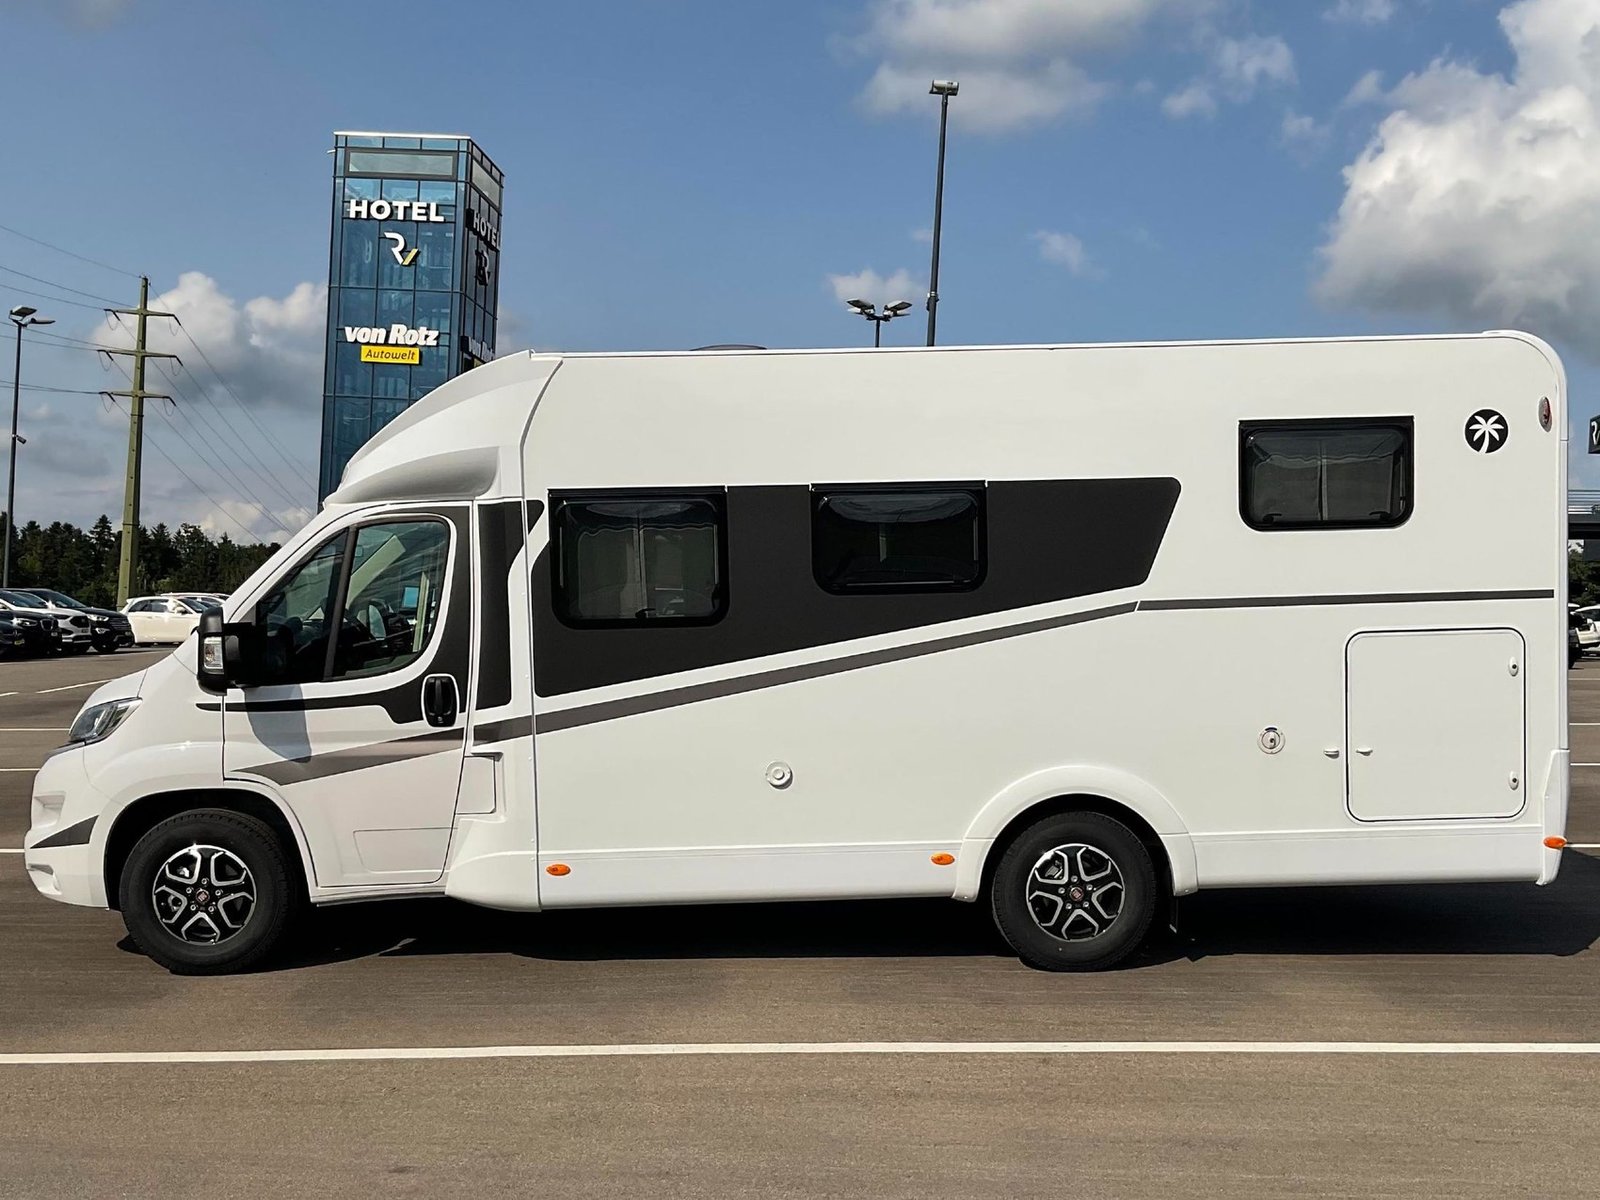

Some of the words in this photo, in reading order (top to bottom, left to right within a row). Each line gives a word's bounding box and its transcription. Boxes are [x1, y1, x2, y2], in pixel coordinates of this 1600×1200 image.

[349, 199, 444, 222] HOTEL
[473, 210, 500, 249] HOTEL
[344, 326, 386, 343] von
[388, 323, 439, 346] Rotz
[365, 349, 415, 360] Autowelt
